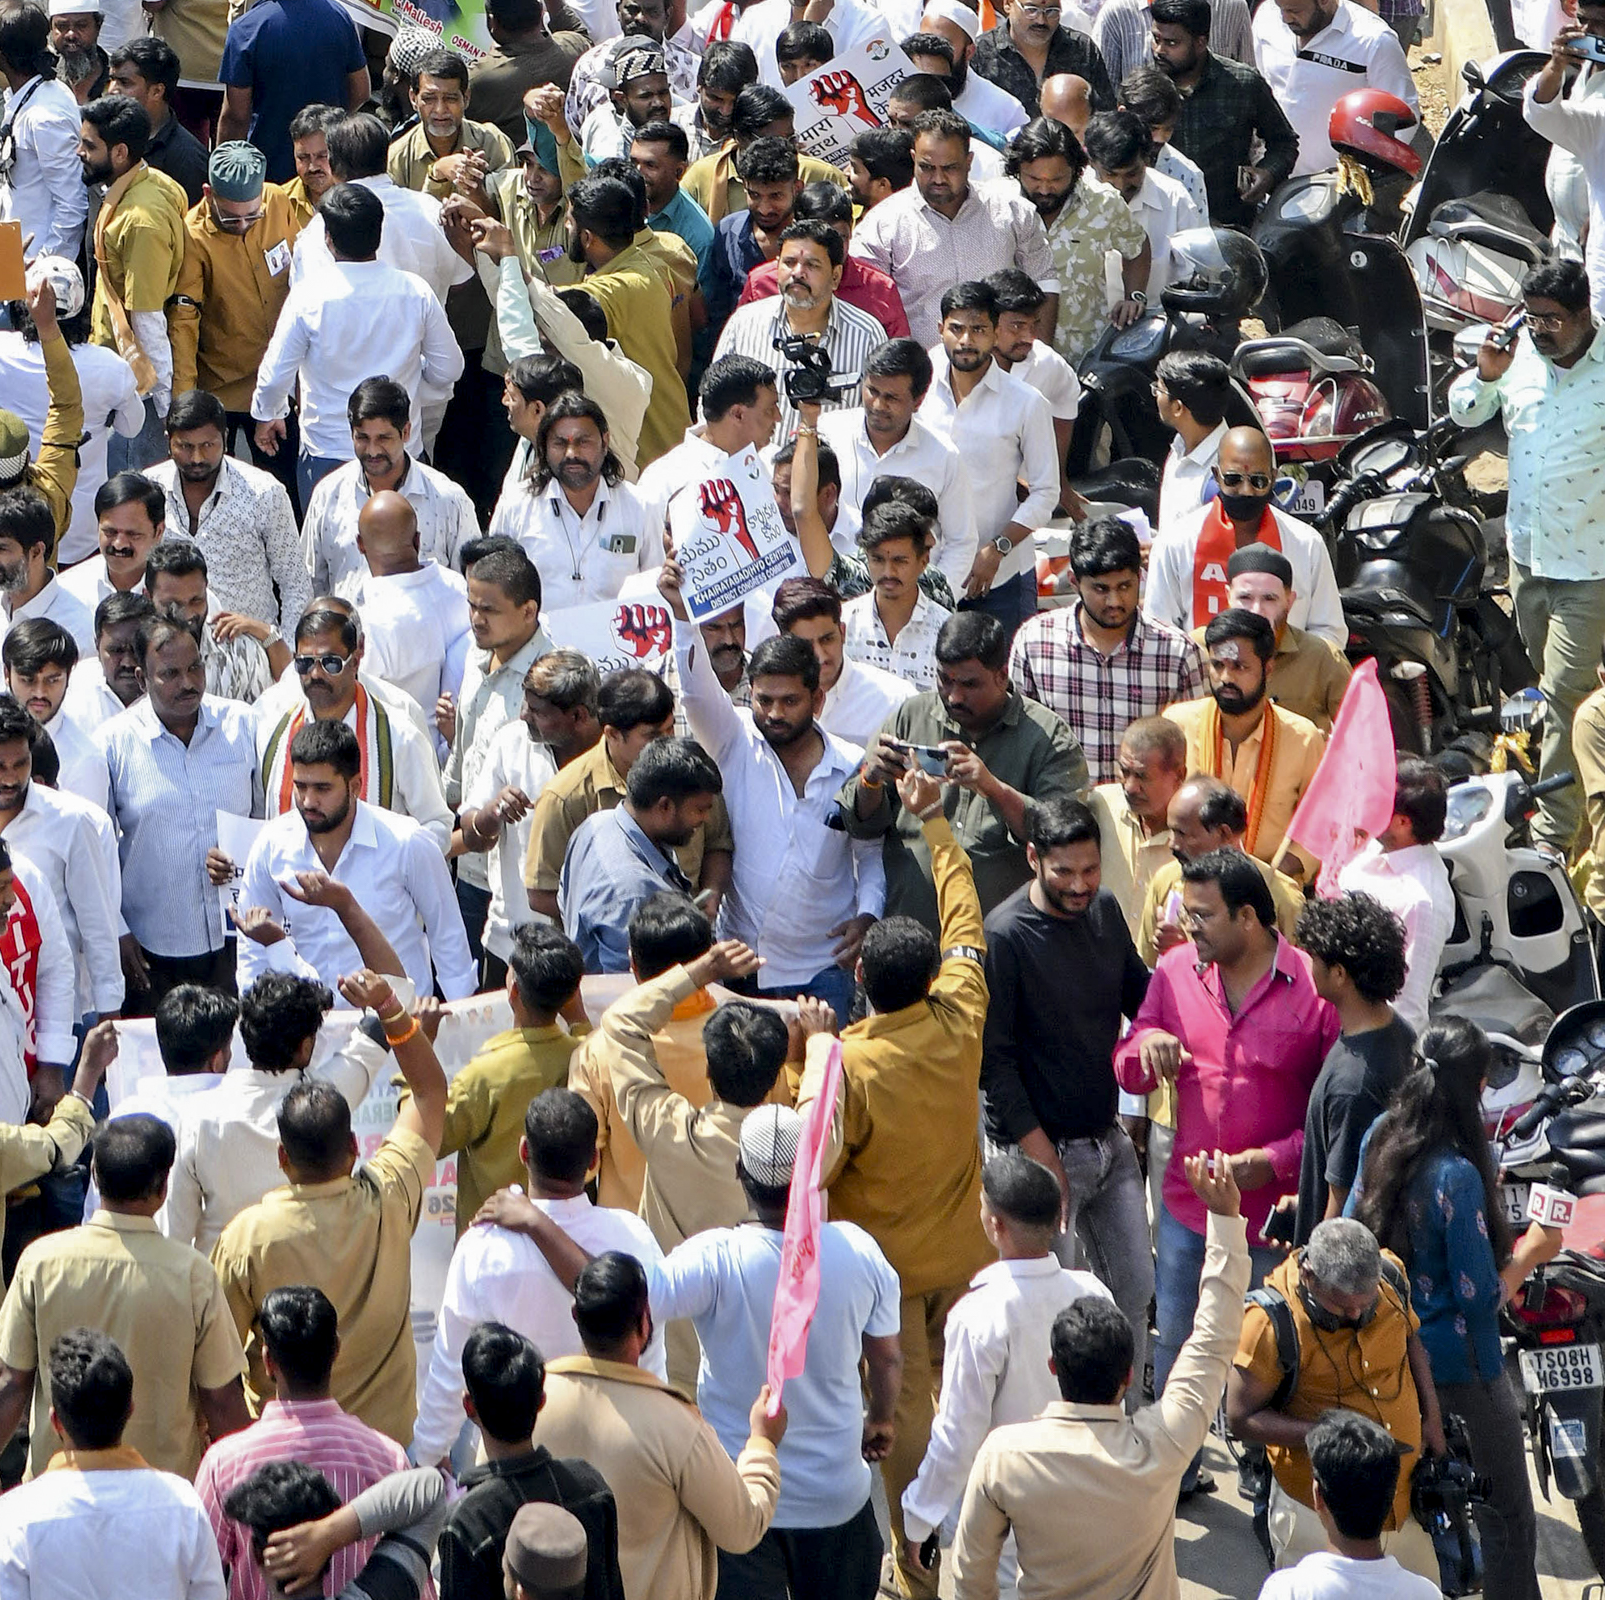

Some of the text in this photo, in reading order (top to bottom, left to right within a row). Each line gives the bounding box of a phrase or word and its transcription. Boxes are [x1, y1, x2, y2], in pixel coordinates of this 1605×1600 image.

[451, 35, 480, 55] OSMAN
[1312, 53, 1348, 70] PRADA
[711, 558, 790, 609] DISTRICT CONGRESS COMMITTEE
[1534, 1348, 1591, 1370] TS08H
